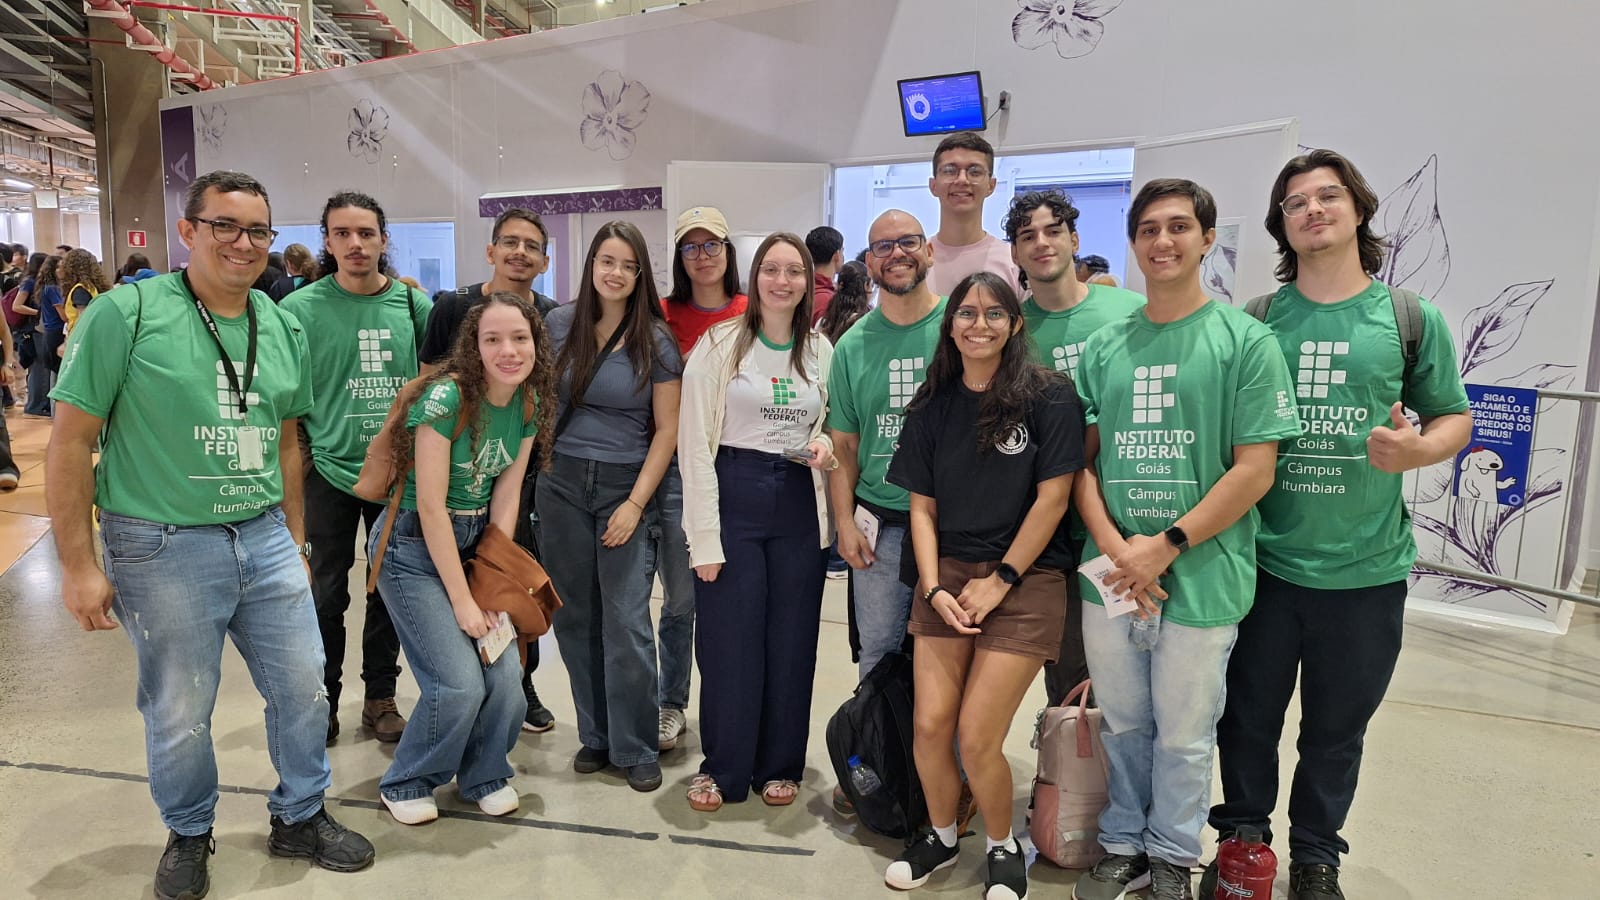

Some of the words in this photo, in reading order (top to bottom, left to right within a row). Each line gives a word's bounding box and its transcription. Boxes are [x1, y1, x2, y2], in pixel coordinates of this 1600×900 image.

[352, 387, 402, 399] FEDERA
[1482, 393, 1506, 402] SIGA
[1507, 395, 1515, 403] O
[760, 407, 808, 417] INSTITUTO
[1297, 405, 1368, 421] TITUTO
[1468, 400, 1521, 413] CARAMELO
[1523, 406, 1530, 414] E
[763, 414, 800, 424] FEDERAL
[1471, 409, 1515, 421] ESCUBRA
[1517, 414, 1532, 423] OS
[362, 419, 385, 429] Câm
[1300, 420, 1358, 436] DERAL
[1472, 418, 1514, 430] GREDOS
[1516, 423, 1531, 432] DO
[1114, 429, 1195, 445] NSTITUTO
[1478, 428, 1512, 439] SIRIUS!
[1296, 438, 1335, 450] Goiás
[1118, 445, 1186, 460] FEDERAL
[1136, 462, 1171, 474] Goiás
[1287, 462, 1343, 478] Câmpus
[1282, 479, 1345, 494] Itumbiara
